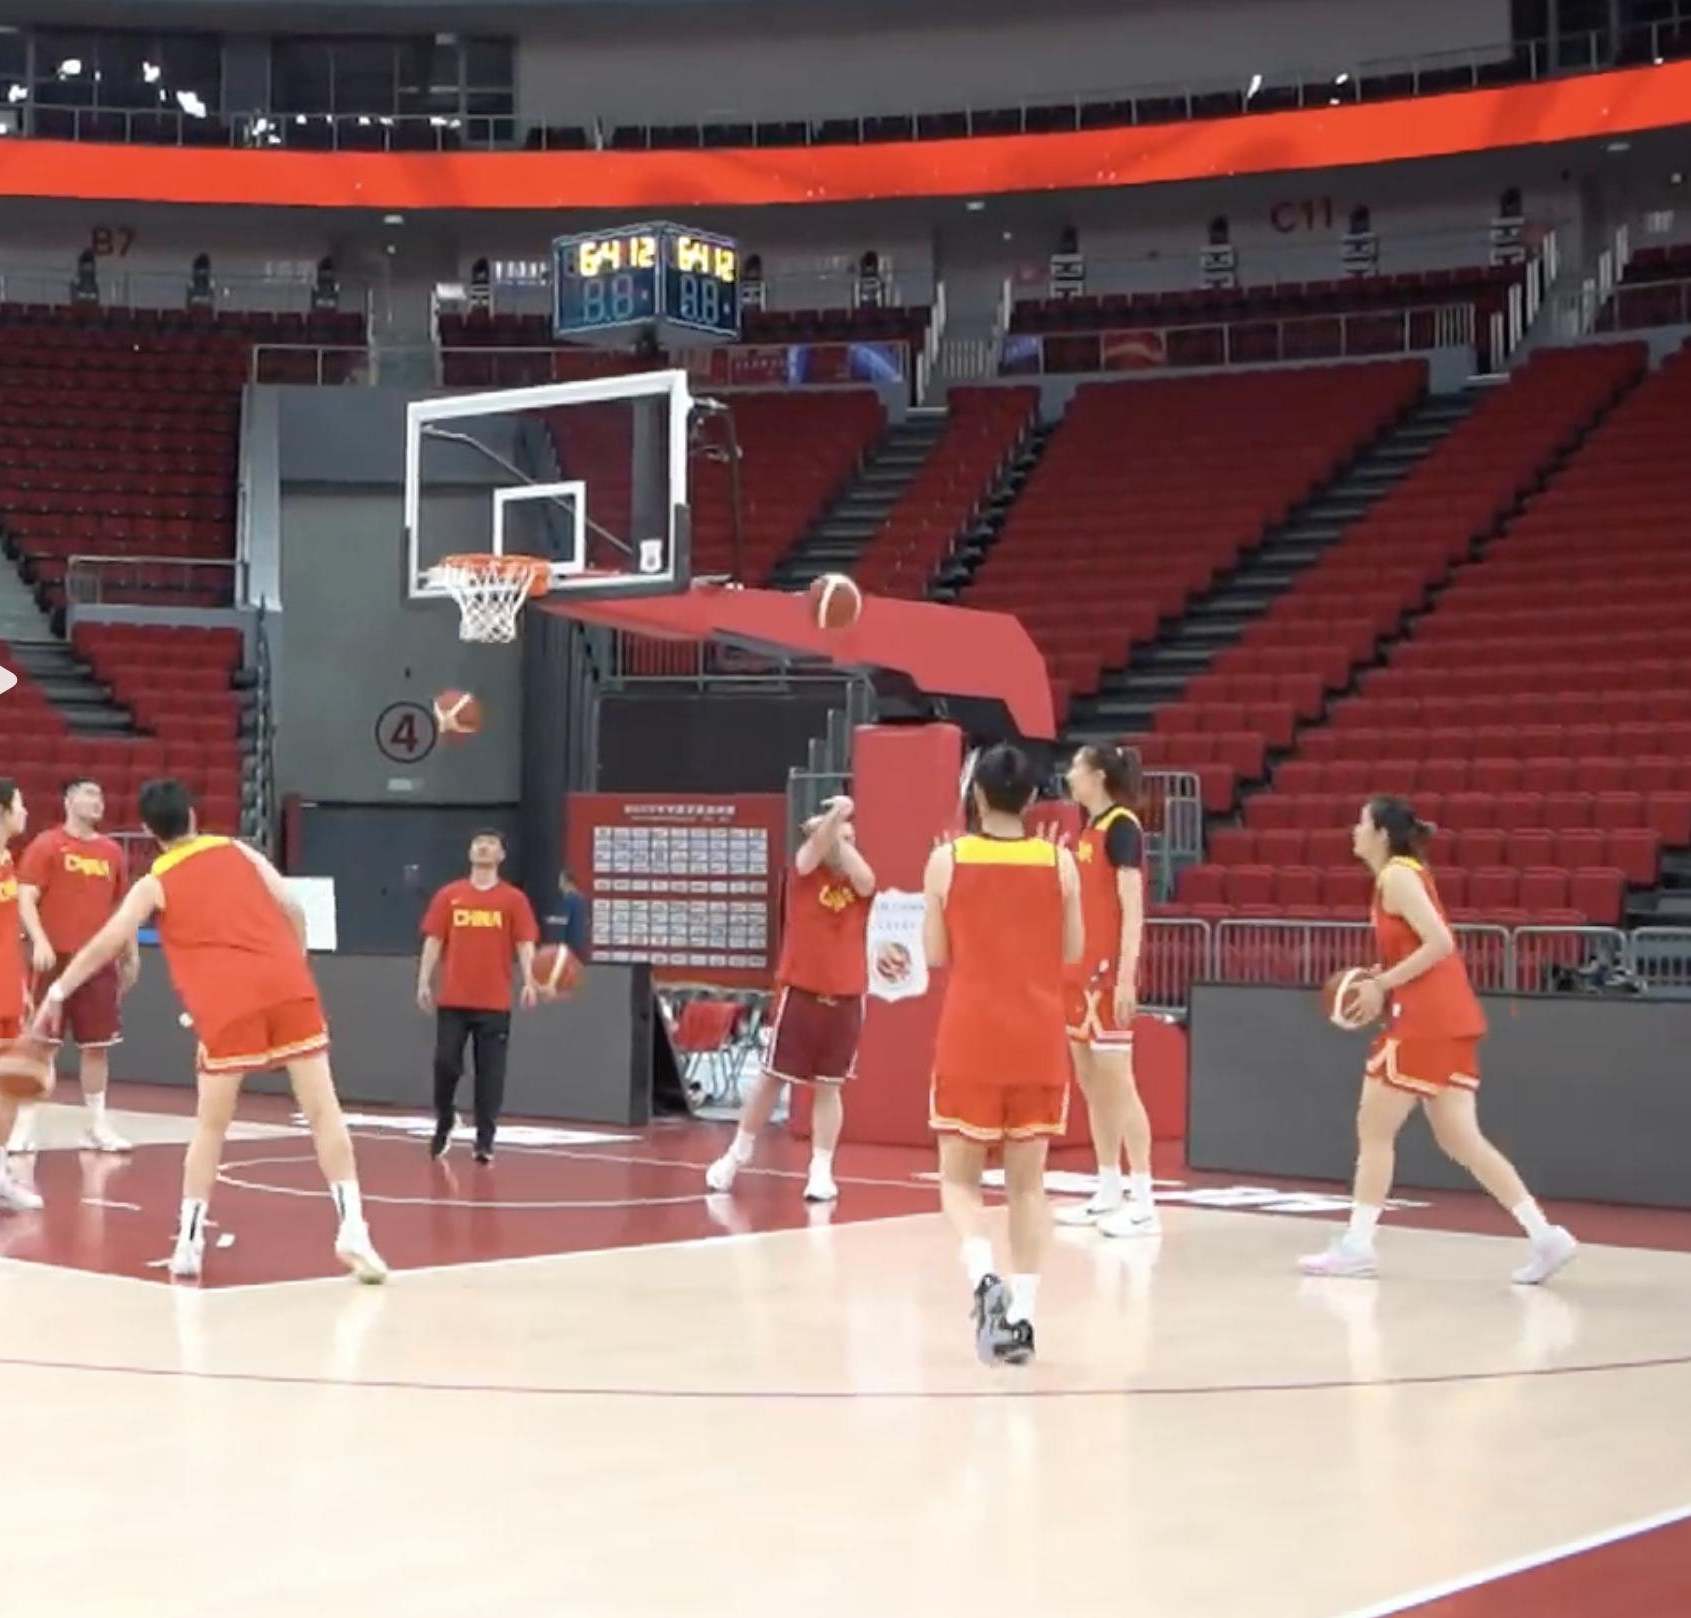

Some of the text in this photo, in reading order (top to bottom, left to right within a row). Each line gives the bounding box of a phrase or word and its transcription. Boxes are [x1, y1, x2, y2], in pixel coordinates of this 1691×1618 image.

[1270, 197, 1331, 233] C11
[92, 227, 136, 256] B7
[390, 714, 419, 753] 4
[452, 908, 503, 929] CHINA
